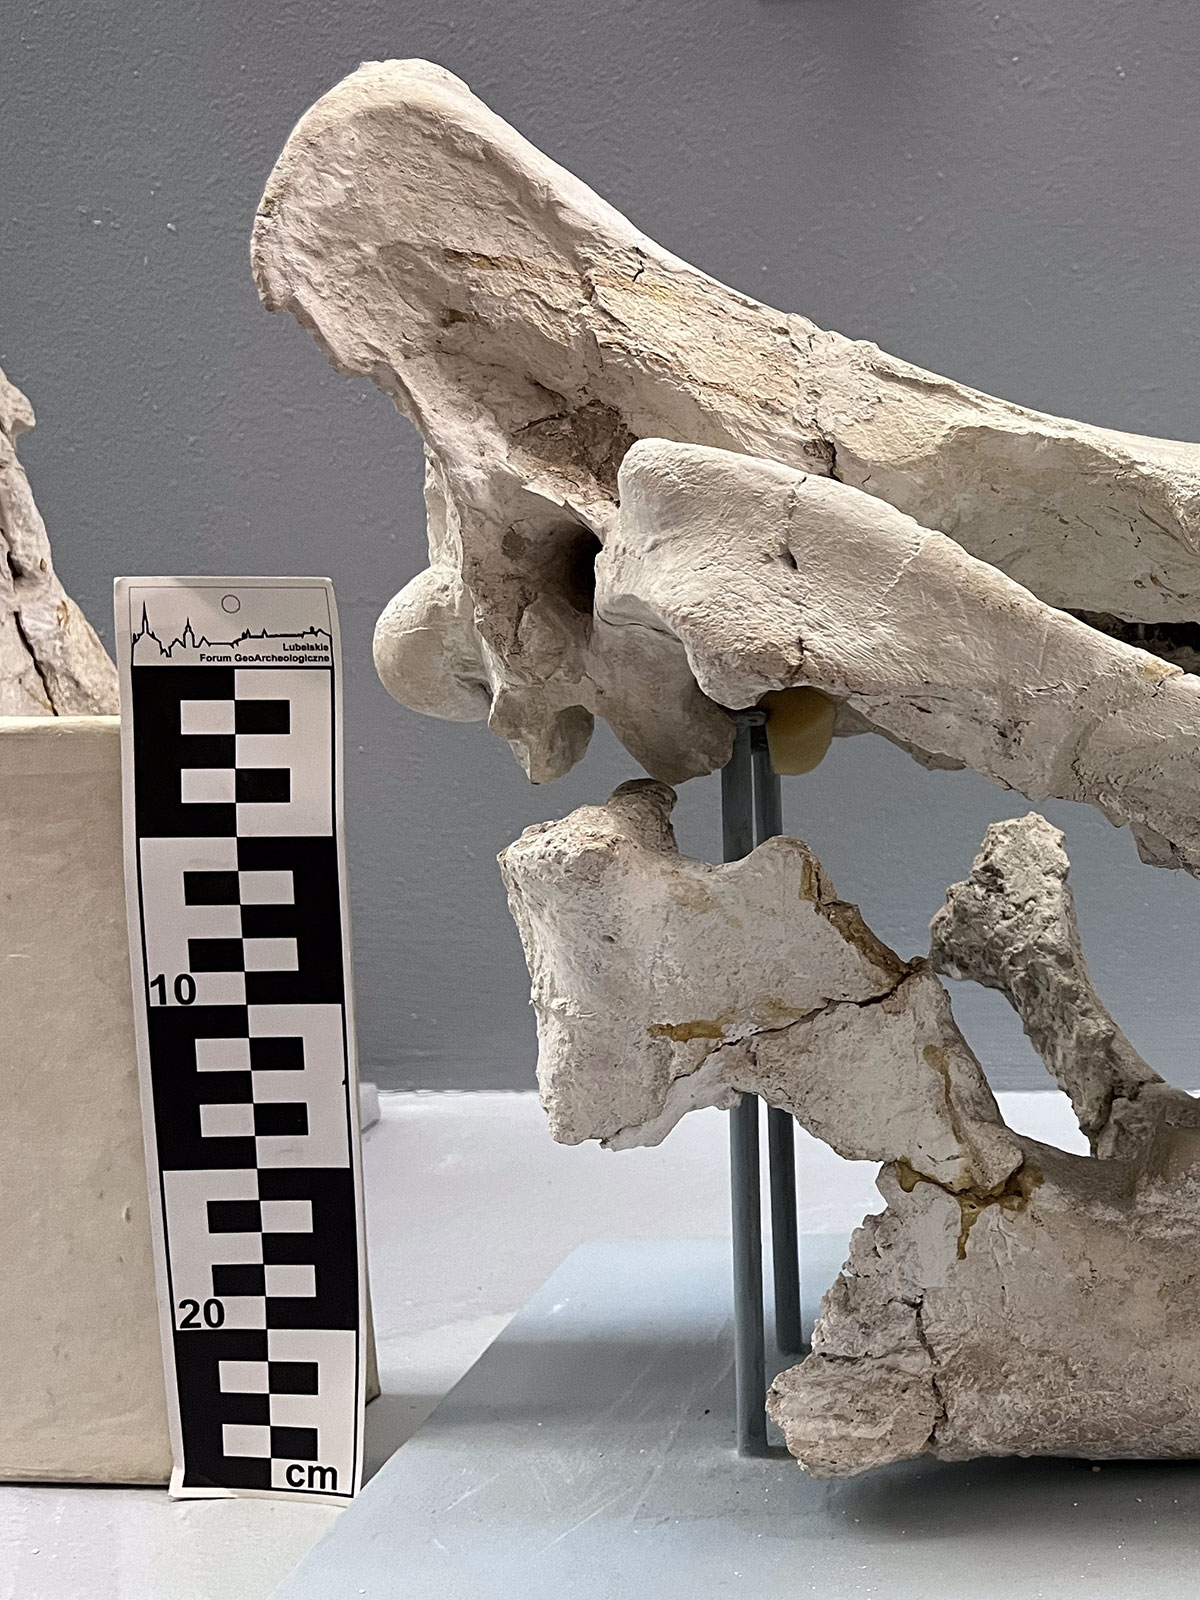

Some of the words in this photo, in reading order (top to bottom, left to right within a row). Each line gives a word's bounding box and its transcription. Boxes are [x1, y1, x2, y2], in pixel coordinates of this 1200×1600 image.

[199, 653, 232, 662] Forum
[234, 653, 330, 664] GeoArcheologiczne
[282, 643, 330, 652] Lubelskie
[149, 973, 197, 1006] 10
[178, 1298, 226, 1329] 20
[285, 1463, 339, 1491] cm
